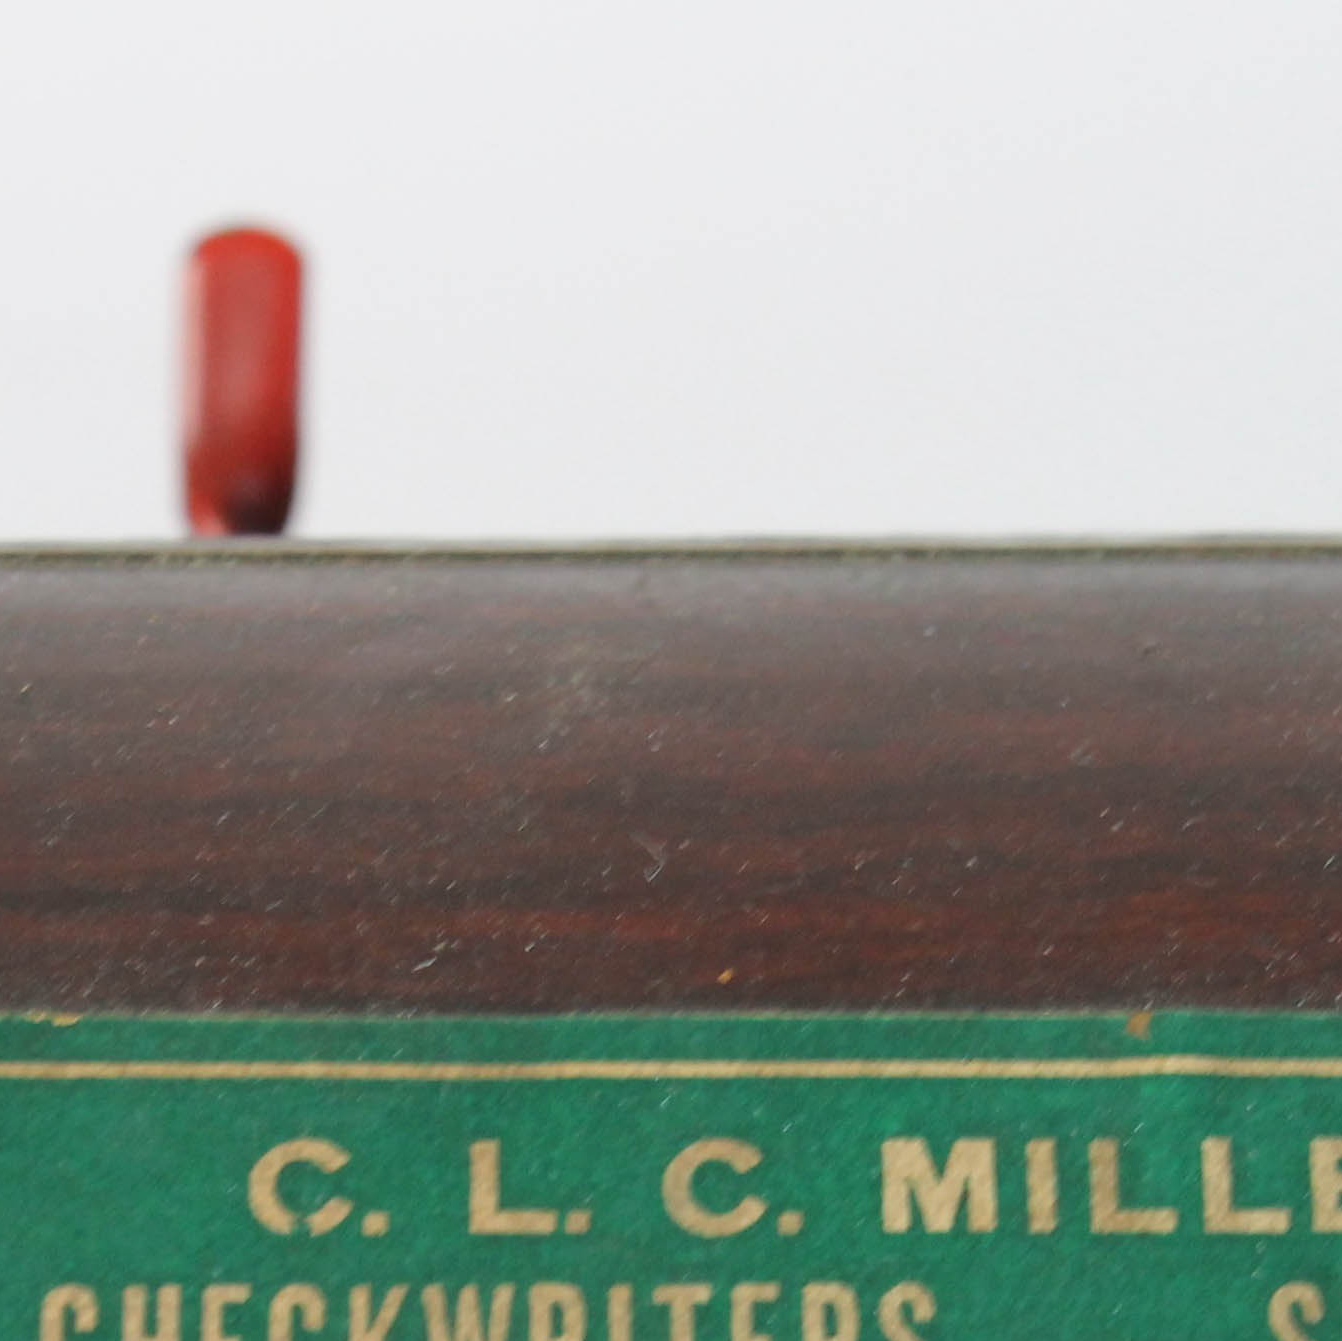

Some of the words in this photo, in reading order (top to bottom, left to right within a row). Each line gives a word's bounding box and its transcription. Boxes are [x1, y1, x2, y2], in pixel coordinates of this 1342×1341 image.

[247, 1137, 390, 1237] C.
[468, 1139, 591, 1236] L.
[661, 1137, 803, 1238] C.
